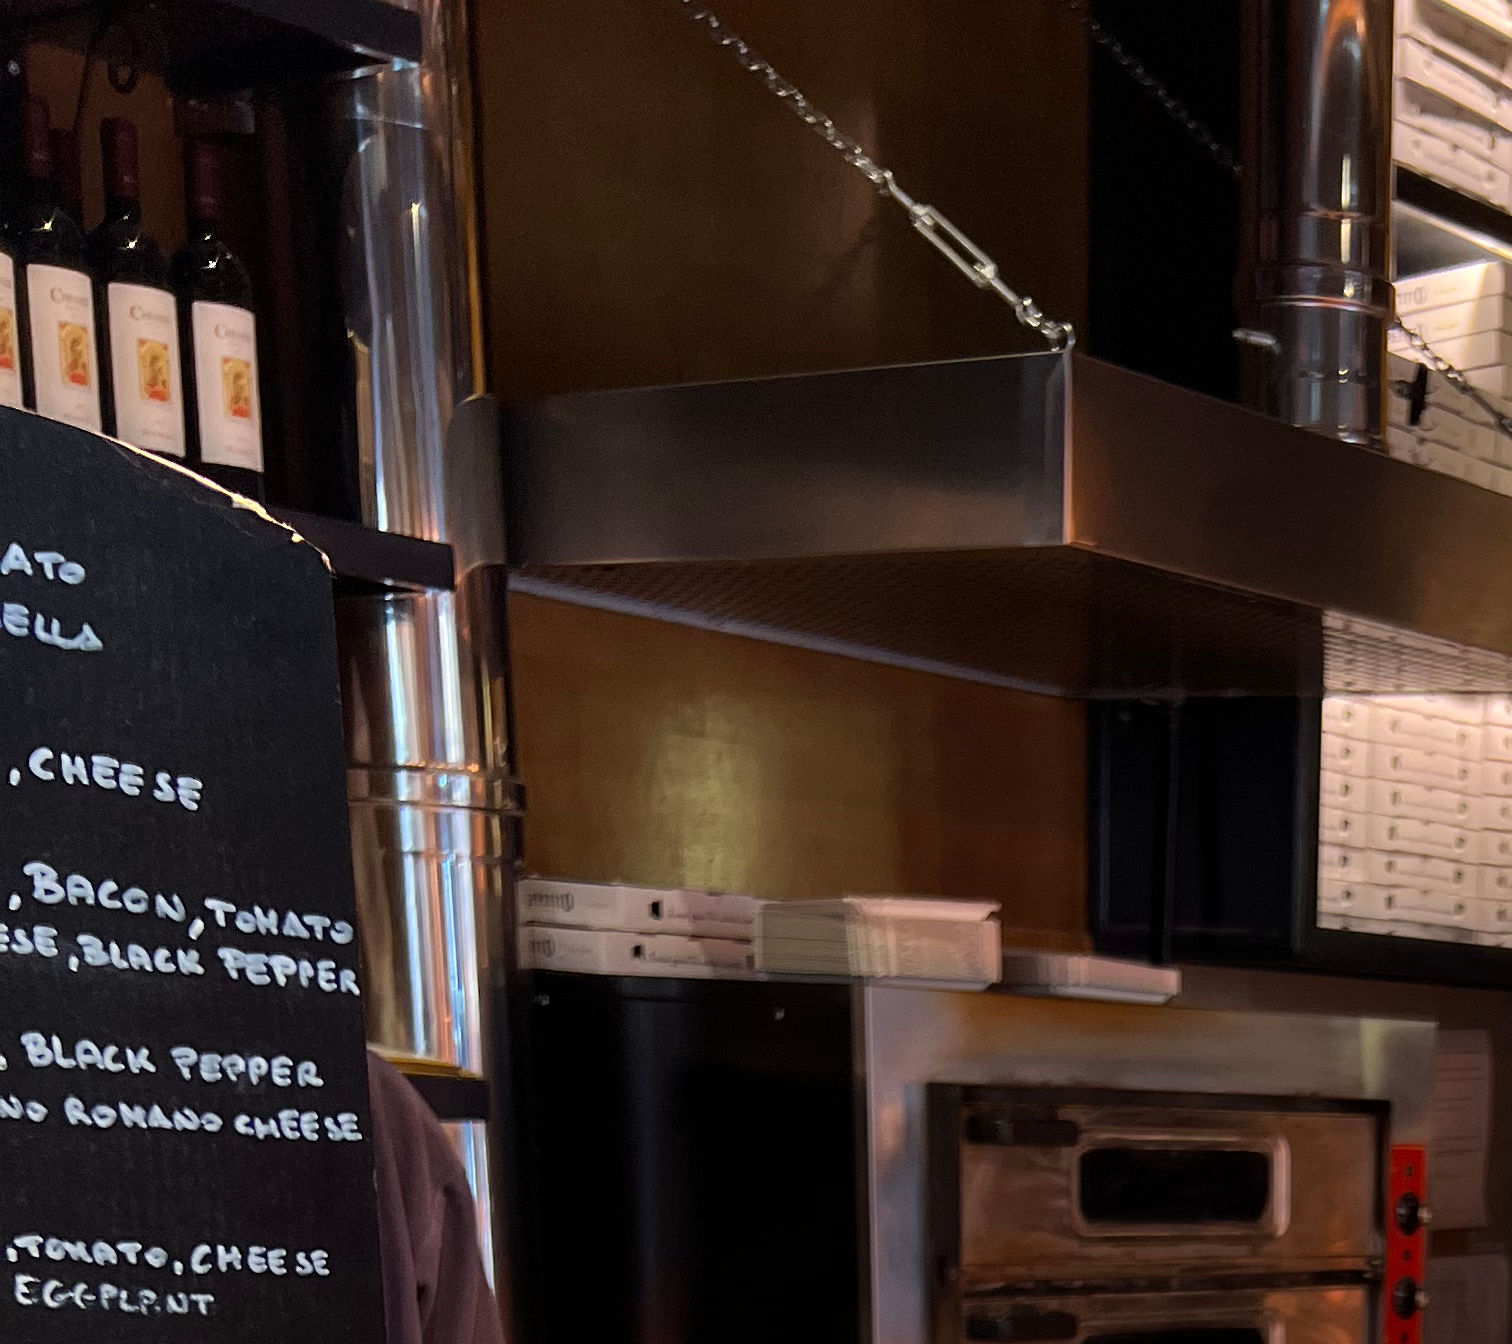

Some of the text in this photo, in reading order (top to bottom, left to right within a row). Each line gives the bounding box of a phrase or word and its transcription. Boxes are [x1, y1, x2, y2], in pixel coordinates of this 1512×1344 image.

[216, 946, 361, 997] PEPPER
[19, 1031, 324, 1088] BLACK PEPPER
[63, 1094, 224, 1133] ROMANO
[233, 1107, 363, 1142] CHEESE
